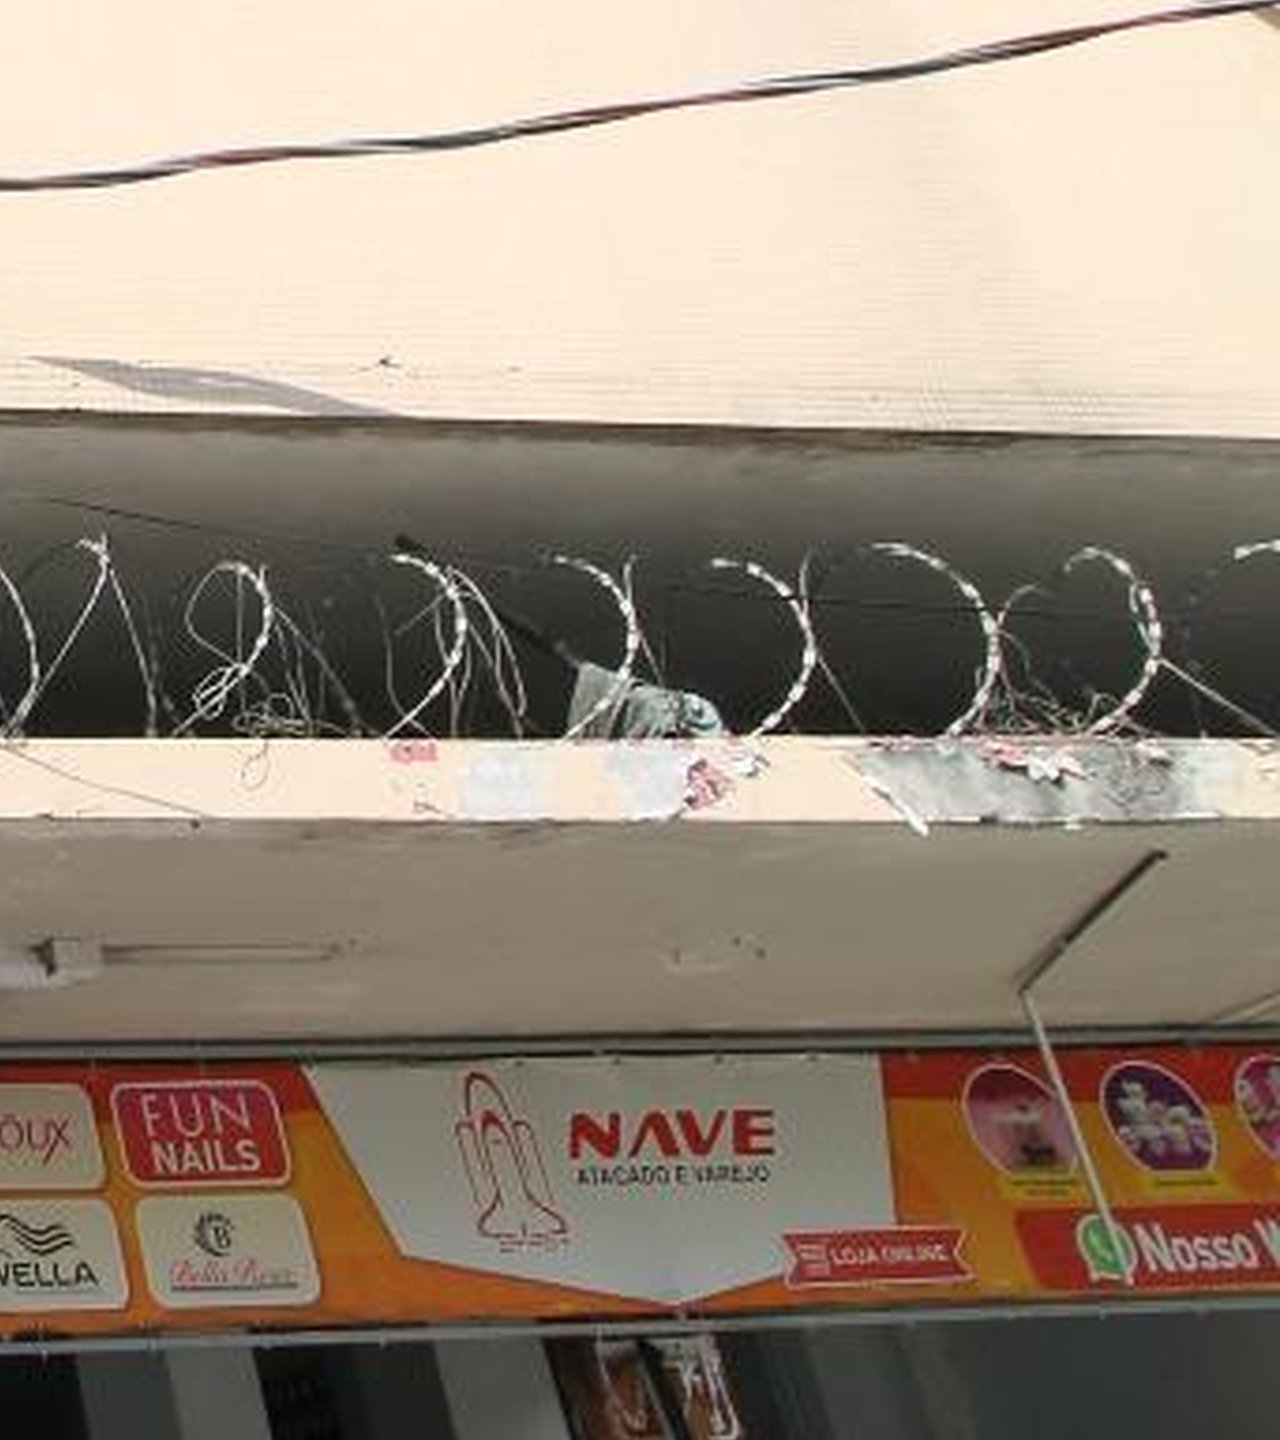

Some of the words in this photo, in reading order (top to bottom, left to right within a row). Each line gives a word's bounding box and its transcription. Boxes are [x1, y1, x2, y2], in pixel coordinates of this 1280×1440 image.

[140, 1093, 251, 1136] FUN
[568, 1109, 775, 1158] NAVE
[151, 1139, 261, 1173] NAILS
[1133, 1223, 1258, 1272] Nosso
